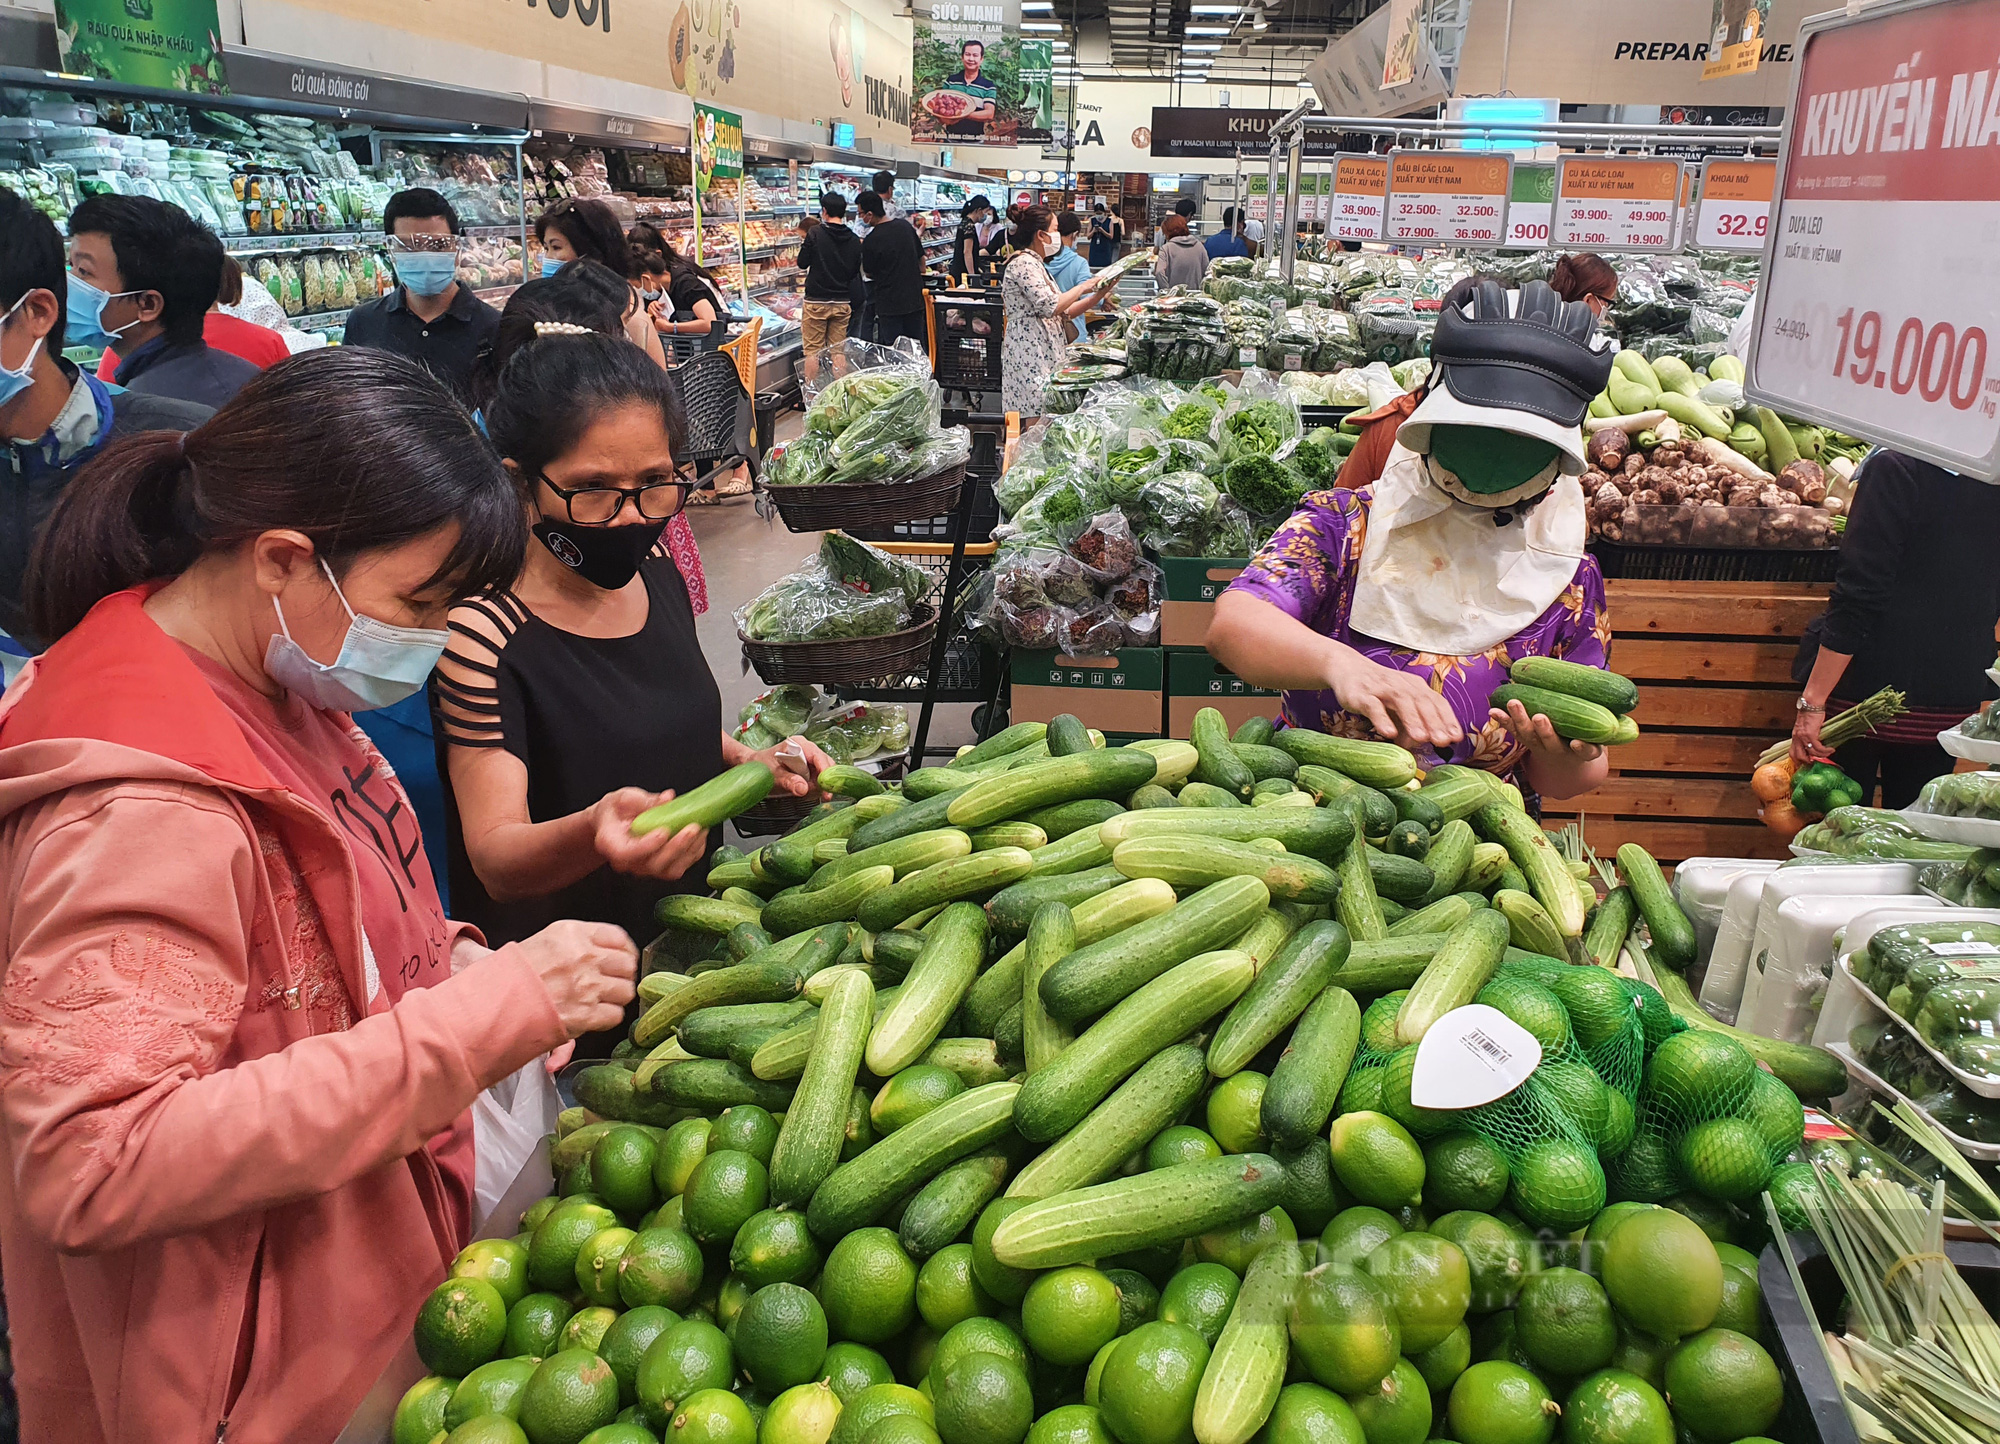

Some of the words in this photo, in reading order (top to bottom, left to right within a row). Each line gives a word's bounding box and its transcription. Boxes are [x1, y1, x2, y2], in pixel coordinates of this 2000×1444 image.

[931, 2, 960, 20] SỨC
[963, 5, 1003, 23] MẠNH
[87, 20, 109, 37] RAU
[968, 23, 985, 33] VIỆT
[1614, 42, 1710, 61] PREPAR
[1759, 44, 1795, 62] ME
[291, 68, 305, 92] CỦ
[307, 72, 326, 96] QUẢ
[328, 76, 353, 98] ĐÓNG
[354, 80, 369, 100] GÓI
[865, 74, 888, 128] THỰC
[1801, 51, 1937, 156] KHUYẾN
[1077, 103, 1103, 113] CEMENT
[1229, 118, 1265, 132] KHU
[715, 116, 730, 149] SIÊU
[730, 120, 743, 155] QUẢ
[1075, 120, 1105, 146] A
[1339, 176, 1356, 185] XUẤT
[1395, 174, 1413, 183] XUẤT
[1428, 175, 1443, 185] VIỆT
[1567, 178, 1586, 188] XUẤT
[1600, 180, 1615, 190] VIỆT
[1710, 174, 1734, 183] KHOAI
[1251, 183, 1268, 191] ORG
[1342, 204, 1376, 216] 38.900
[1400, 204, 1436, 214] 32.500
[1457, 206, 1494, 216] 32.500
[1571, 209, 1607, 220] 39.900
[1628, 210, 1666, 221] 49.900
[1717, 214, 1769, 237] 32.9
[1788, 215, 1806, 233] DƯA
[1807, 216, 1823, 234] LEO
[1339, 226, 1373, 238] 54.900
[1397, 227, 1434, 237] 37.900
[1455, 228, 1491, 239] 36.900
[1509, 223, 1549, 239] .900
[1568, 232, 1605, 243] 31.500
[1626, 234, 1663, 245] 19.900
[1812, 244, 1825, 265] VIỆT
[1825, 249, 1842, 263] NAM
[1833, 307, 1987, 410] 19.000
